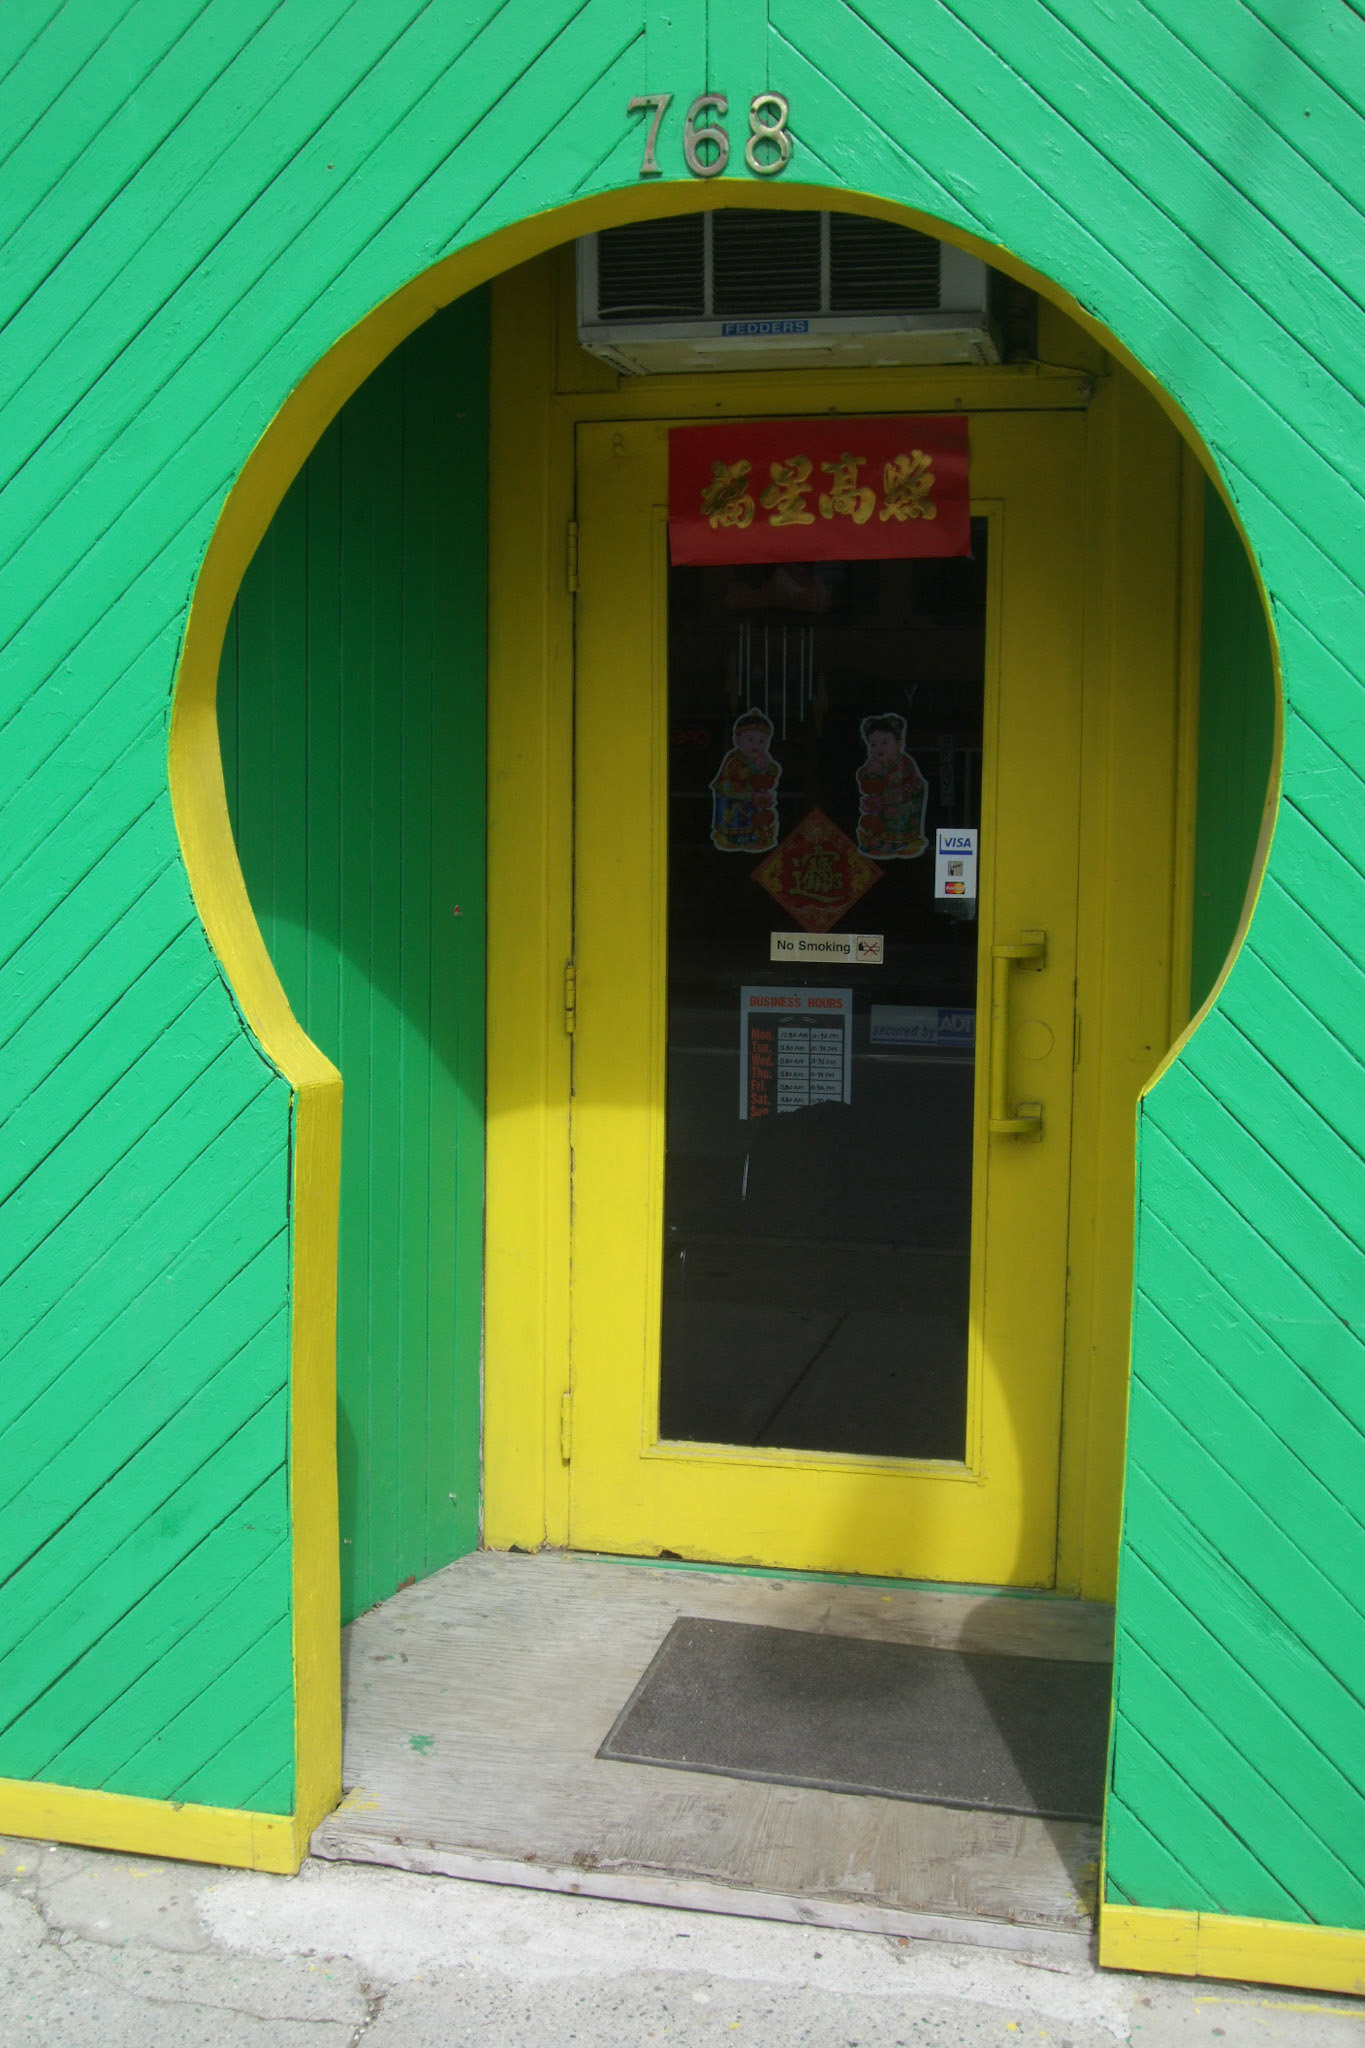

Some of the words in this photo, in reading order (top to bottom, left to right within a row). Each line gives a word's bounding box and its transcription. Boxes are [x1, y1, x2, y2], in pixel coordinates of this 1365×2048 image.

[627, 93, 791, 177] 768
[724, 320, 806, 335] FEDDERS
[700, 449, 938, 529] 福星高照
[944, 836, 972, 848] VISA
[777, 940, 794, 950] No
[798, 940, 851, 954] Smoking
[749, 995, 801, 1008] BUSINESS
[807, 997, 844, 1009] HOURS
[751, 1028, 774, 1040] Mon.
[922, 1025, 937, 1040] by
[940, 1014, 971, 1032] ADT
